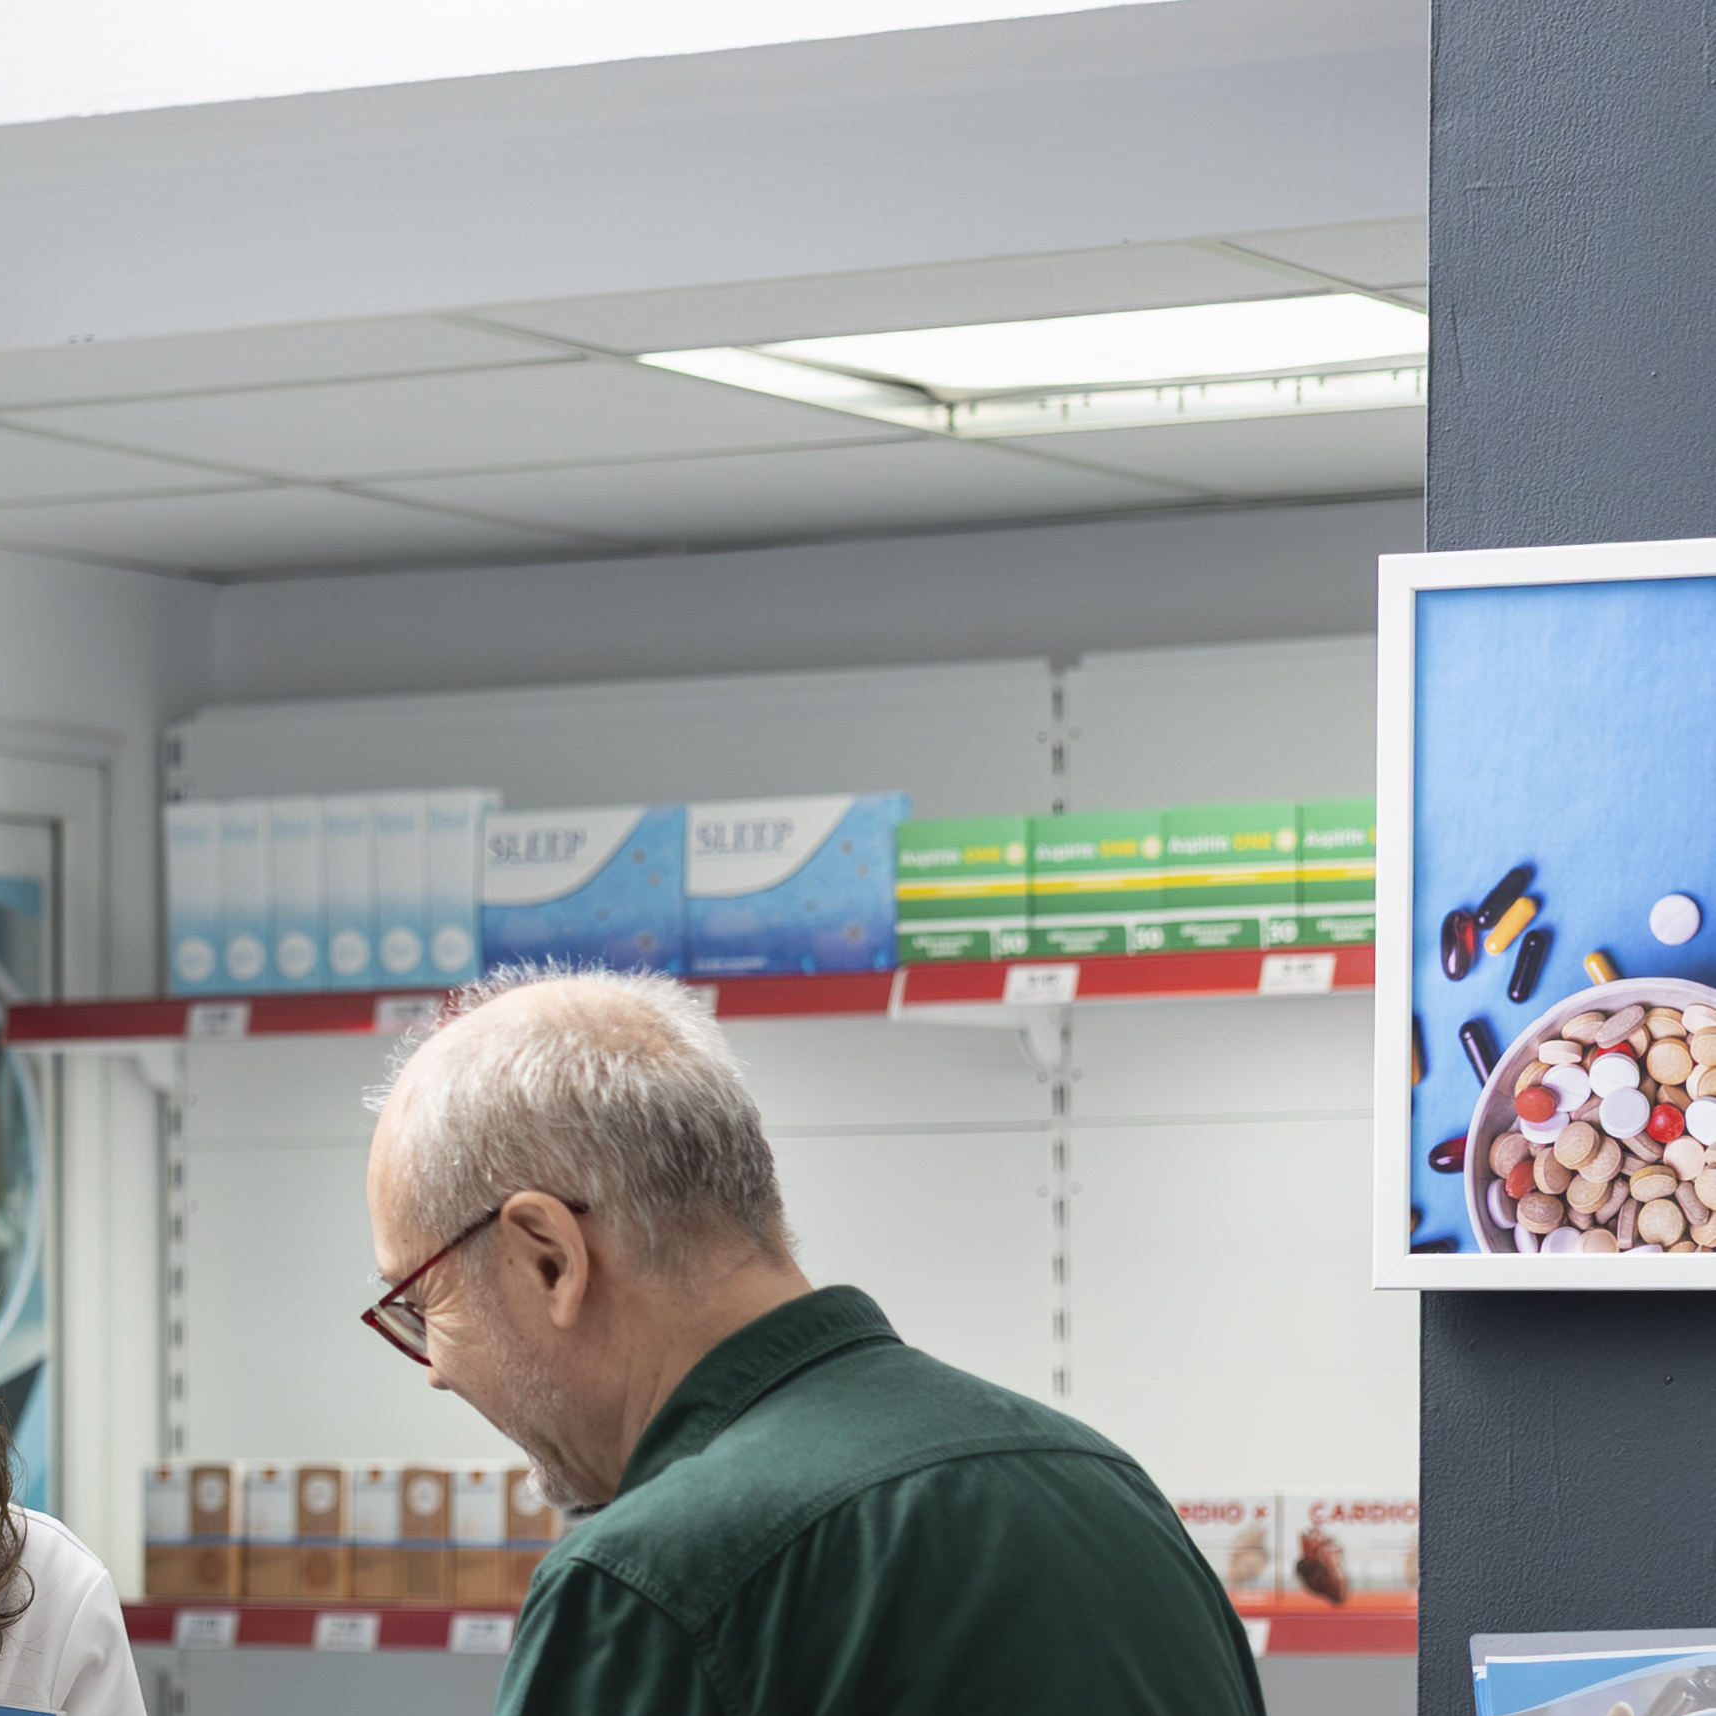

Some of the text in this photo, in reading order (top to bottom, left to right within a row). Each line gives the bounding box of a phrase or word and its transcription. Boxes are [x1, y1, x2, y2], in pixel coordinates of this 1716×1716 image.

[488, 827, 587, 863] SLEEP
[695, 816, 795, 853] SLEEP
[1177, 1501, 1244, 1525] RDIO
[1309, 1500, 1418, 1526] CARDIO
